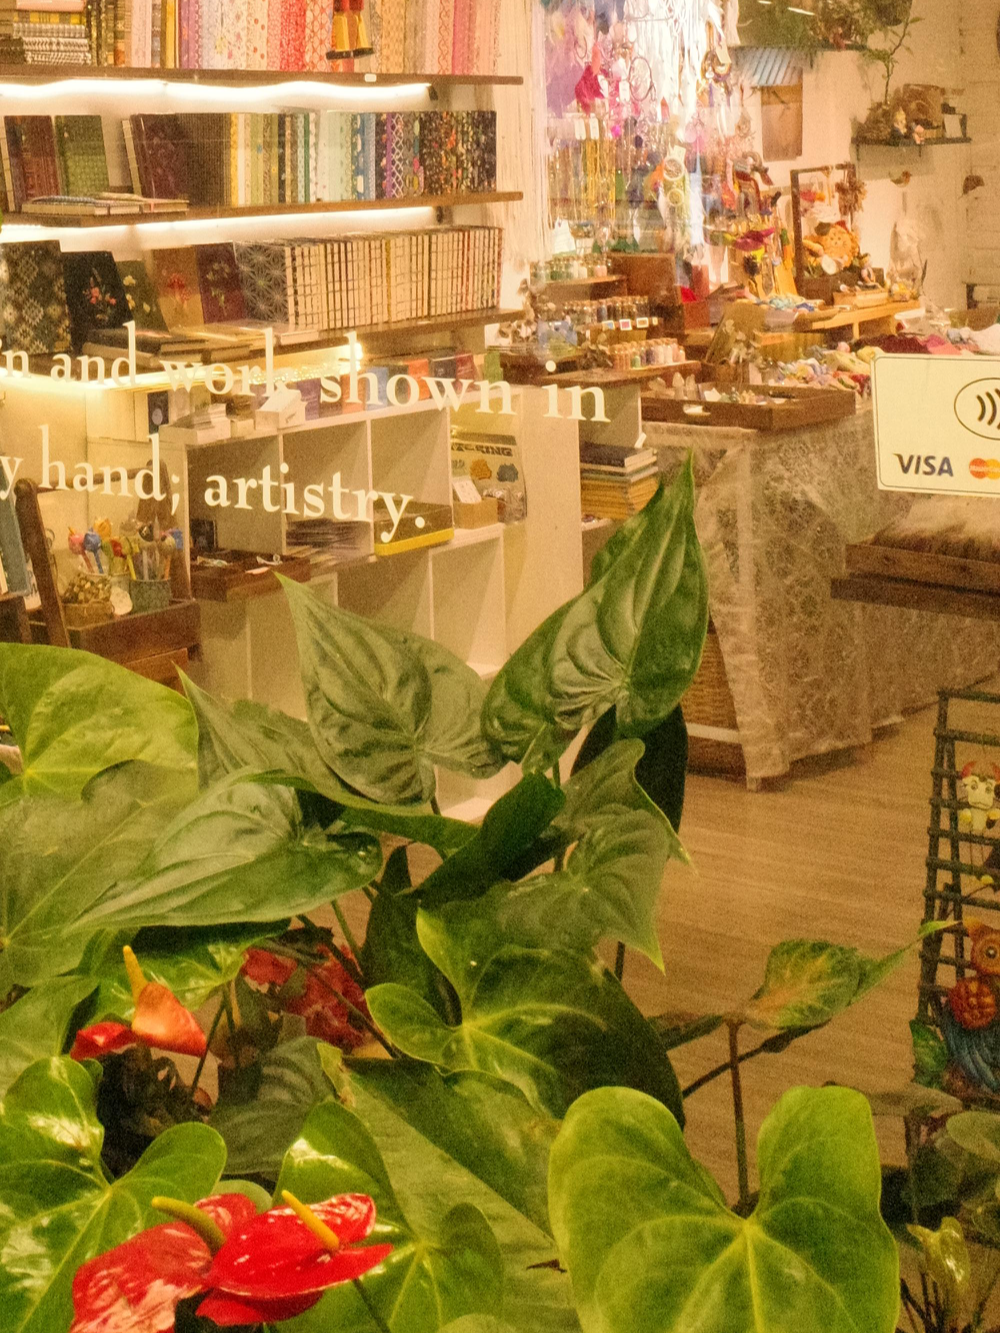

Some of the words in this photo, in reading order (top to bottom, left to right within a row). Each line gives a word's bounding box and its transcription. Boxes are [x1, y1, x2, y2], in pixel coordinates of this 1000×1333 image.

[50, 320, 138, 387] and
[160, 327, 300, 399] work
[320, 330, 517, 417] shown
[543, 359, 611, 424] in
[39, 423, 181, 516] hand;
[203, 462, 426, 544] artistry.
[893, 453, 953, 477] VISA
